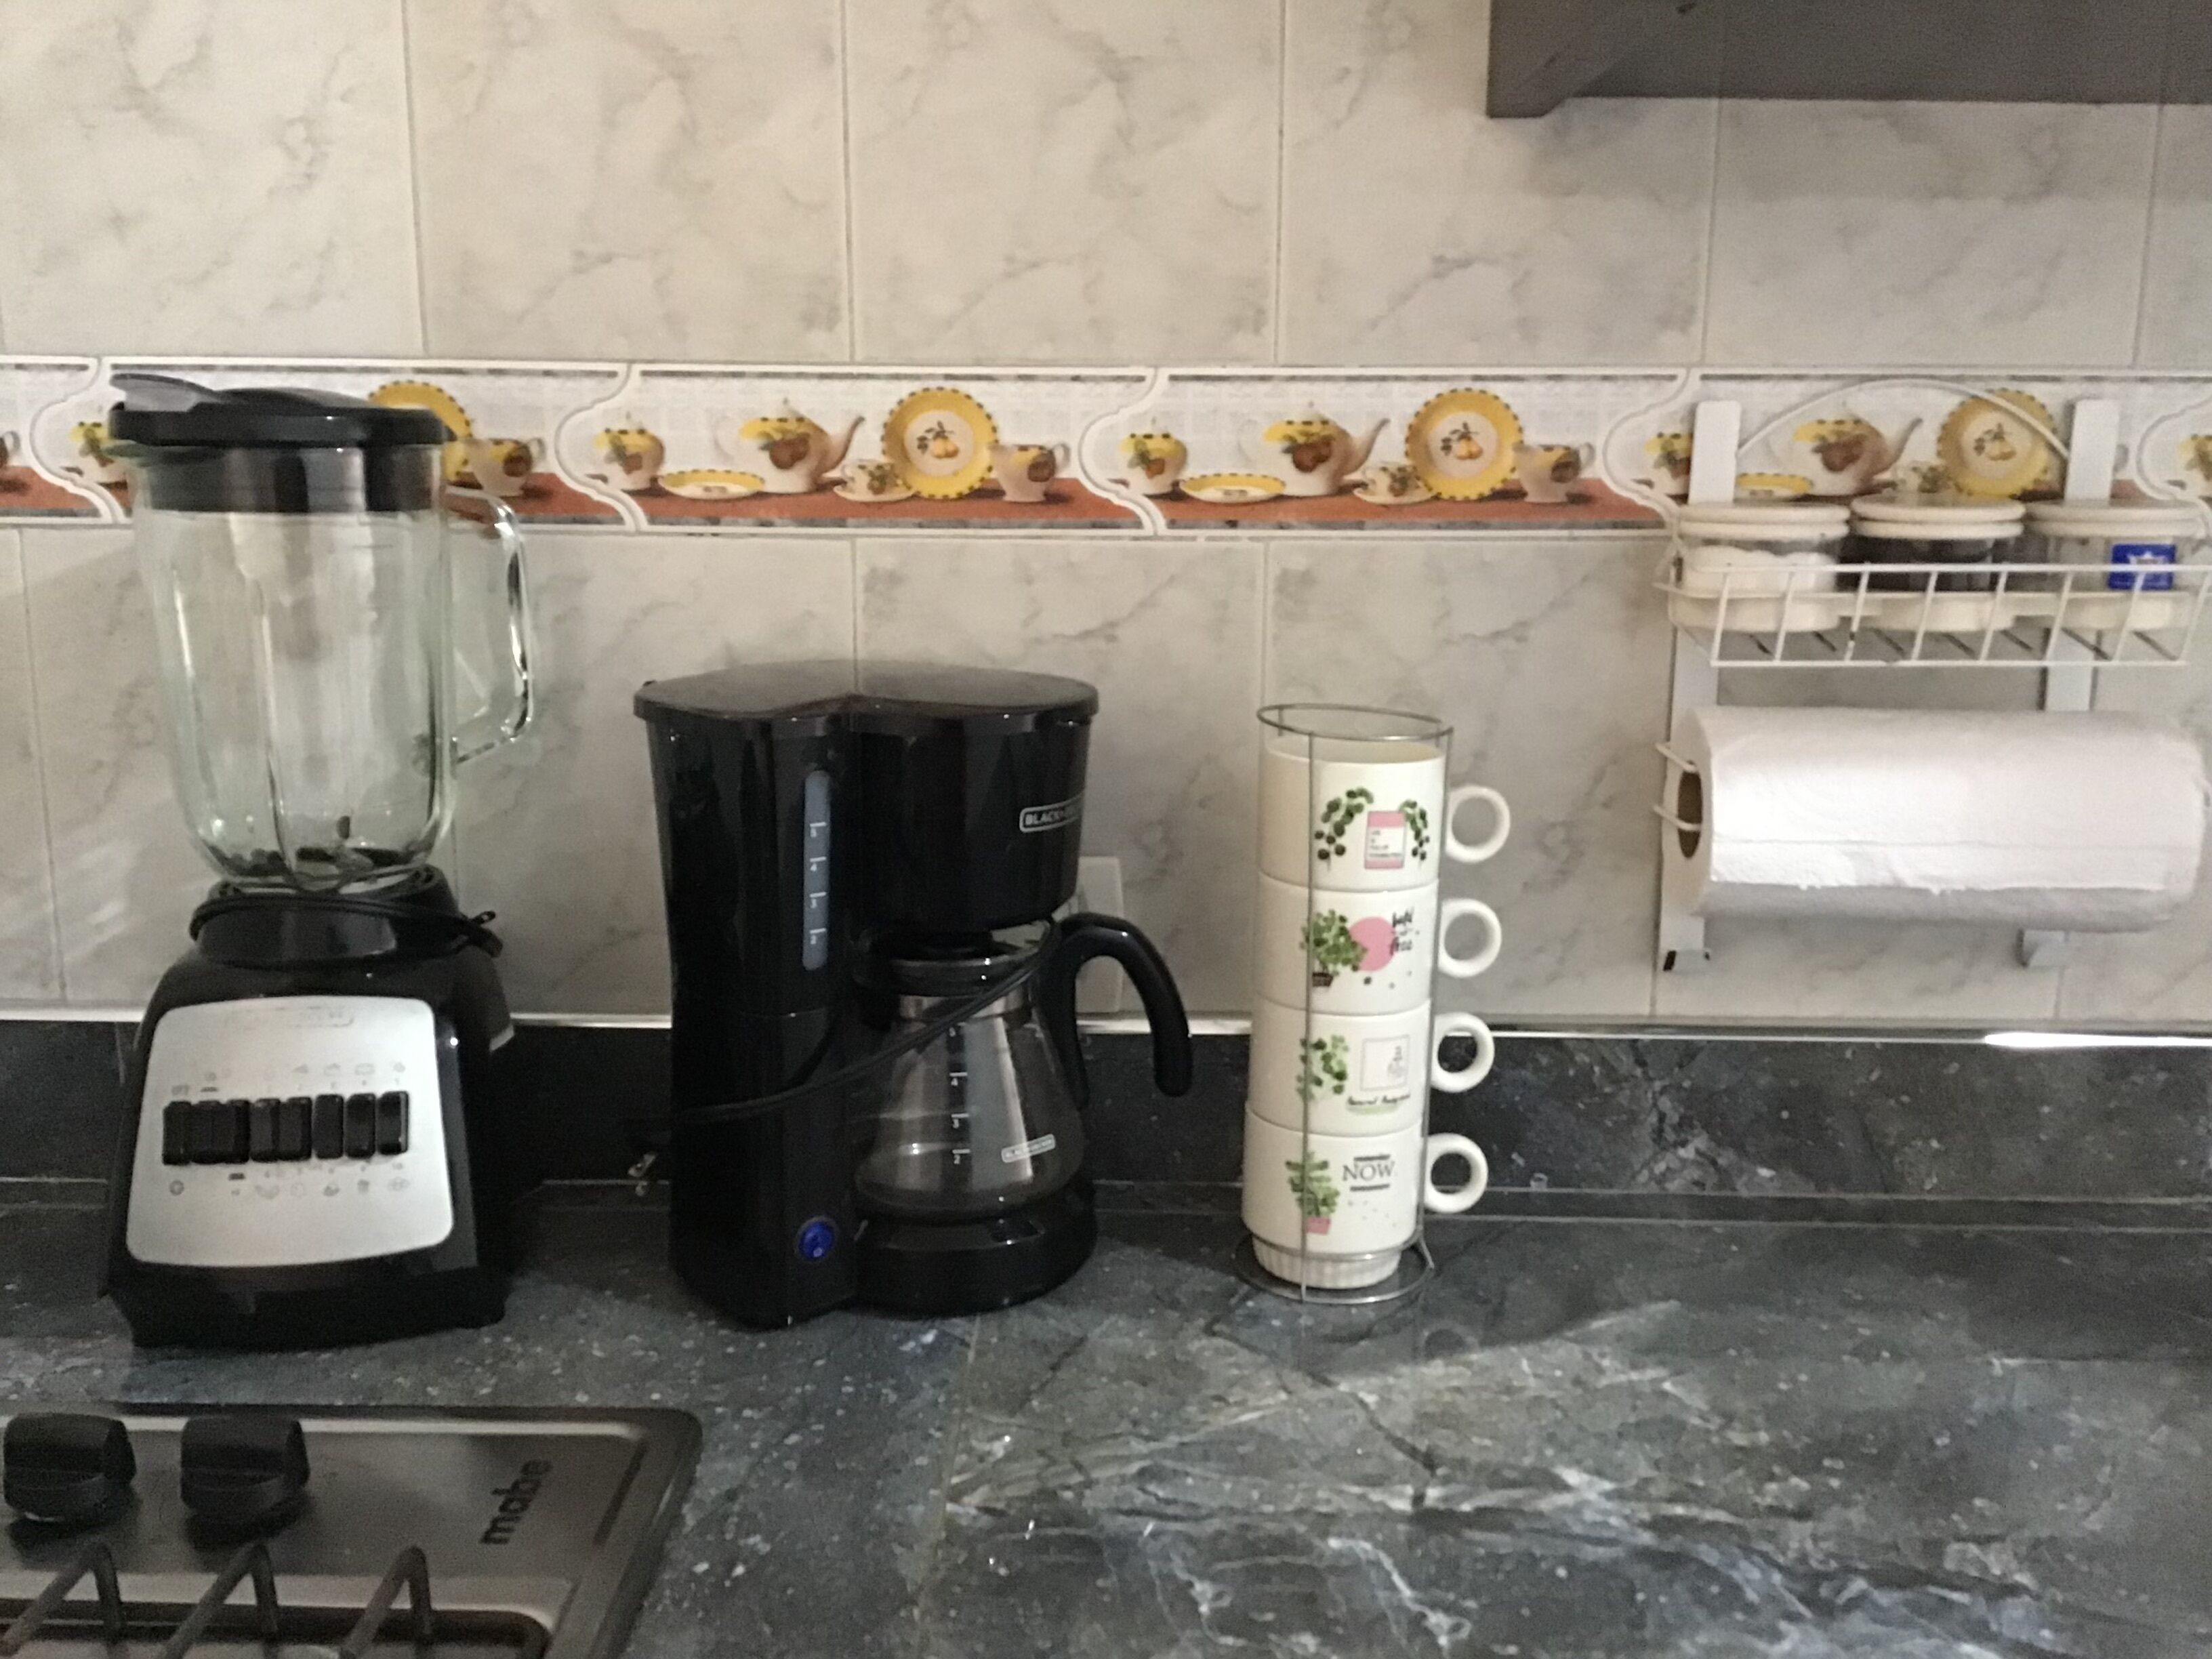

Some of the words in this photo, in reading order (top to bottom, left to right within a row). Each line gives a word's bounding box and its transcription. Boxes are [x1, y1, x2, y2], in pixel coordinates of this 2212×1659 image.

[951, 1078, 959, 1087] 4
[954, 1154, 961, 1165] 2
[1342, 1160, 1395, 1182] NOW
[478, 1458, 554, 1546] mabe
